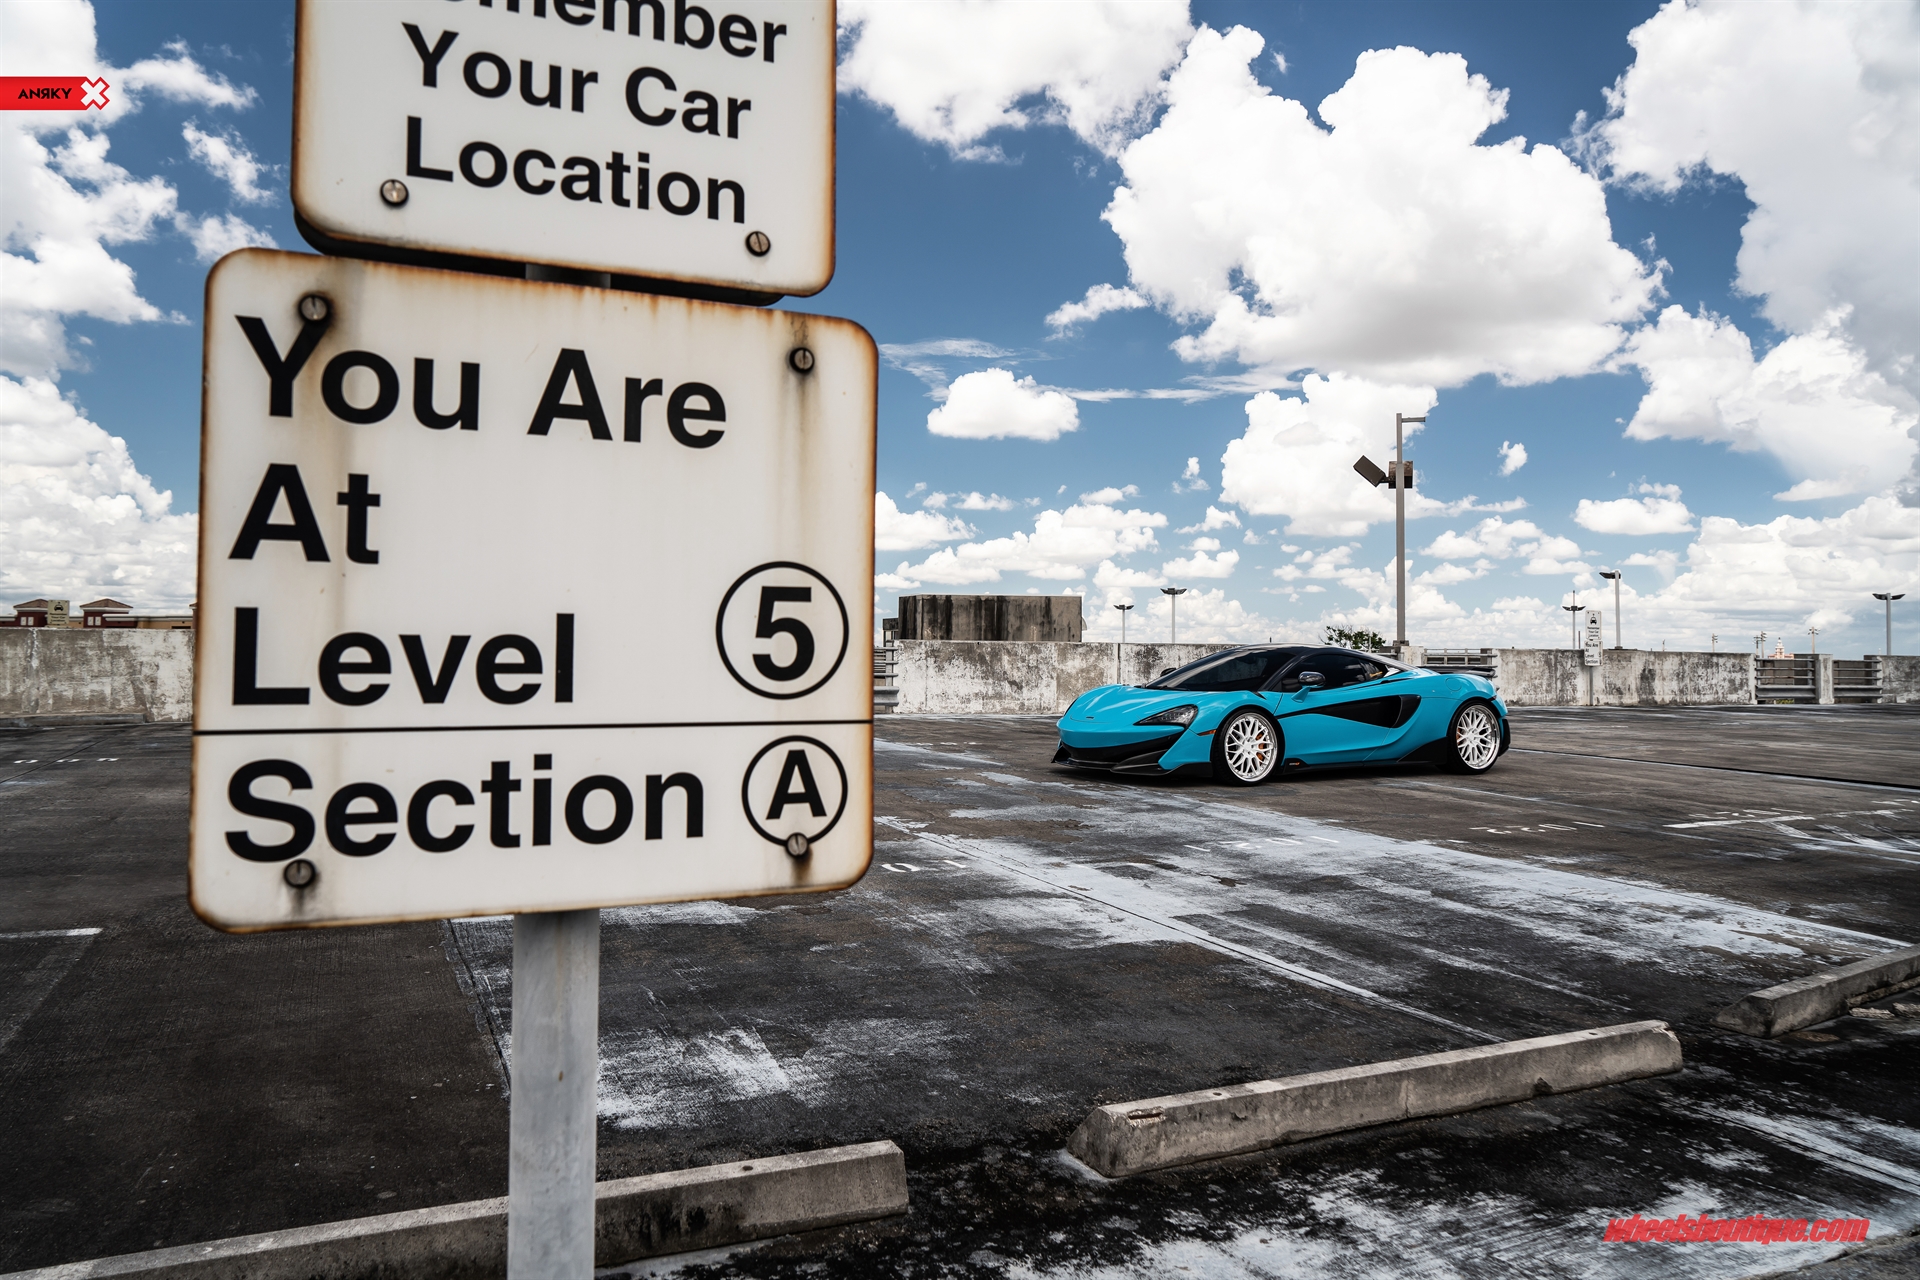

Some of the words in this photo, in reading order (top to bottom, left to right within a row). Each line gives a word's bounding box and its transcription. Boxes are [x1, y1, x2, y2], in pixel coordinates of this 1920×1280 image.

[402, 22, 598, 113] Your
[625, 66, 752, 139] Car
[405, 116, 745, 224] Location
[235, 315, 480, 431] You
[527, 348, 727, 449] Are
[228, 463, 381, 565] At
[231, 607, 575, 706] Level
[752, 586, 816, 682] 5
[224, 754, 704, 864] Section
[765, 748, 828, 820] A
